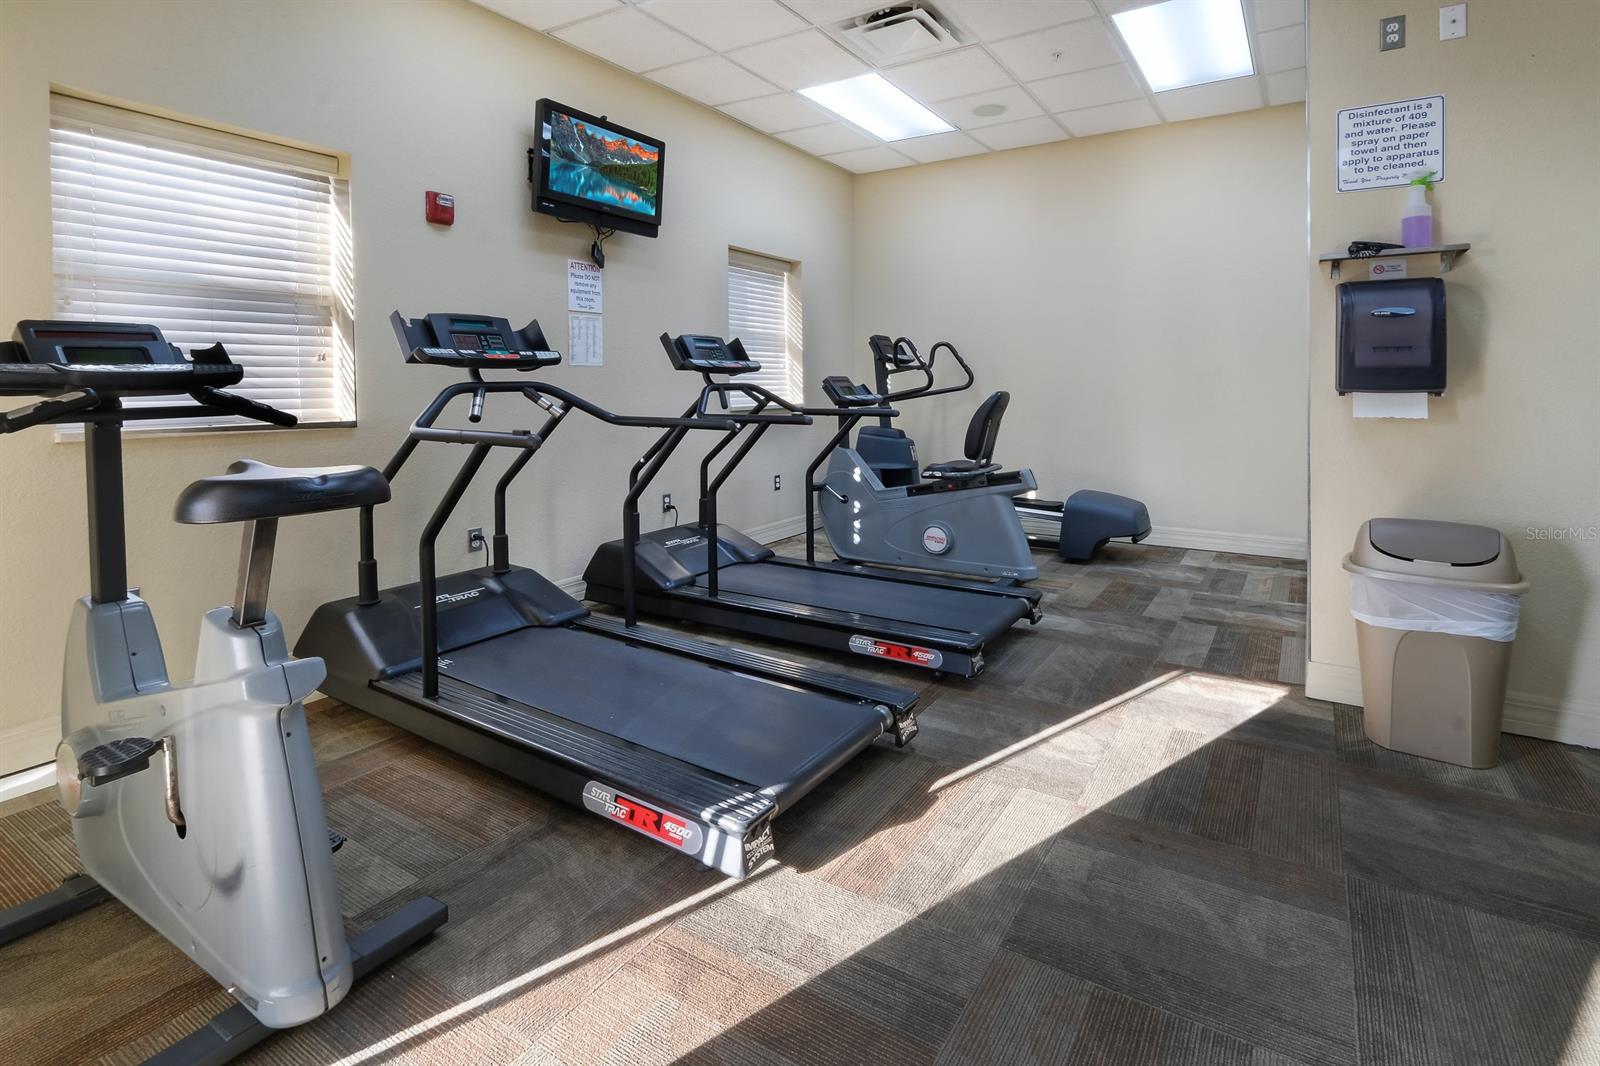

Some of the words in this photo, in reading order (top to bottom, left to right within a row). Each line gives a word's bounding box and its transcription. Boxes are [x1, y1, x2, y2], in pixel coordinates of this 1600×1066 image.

[1348, 104, 1410, 120] Disinfectant
[1353, 116, 1392, 128] mixture
[1394, 115, 1406, 123] of
[1408, 111, 1428, 120] 409
[1344, 130, 1363, 139] and
[1366, 126, 1398, 136] water.
[1401, 120, 1437, 131] Please
[1351, 137, 1380, 148] spray
[1400, 131, 1430, 143] paper
[1350, 146, 1378, 156] towel
[1380, 143, 1400, 153] and
[1403, 141, 1427, 150] then
[1342, 156, 1370, 167] apply
[1386, 149, 1440, 162] apparatus
[1367, 164, 1380, 172] be
[1382, 160, 1427, 171] cleaned.
[570, 262, 600, 273] ATTENTION
[591, 787, 610, 802] STAR
[605, 802, 626, 818] TRAC
[664, 821, 692, 839] 4500
